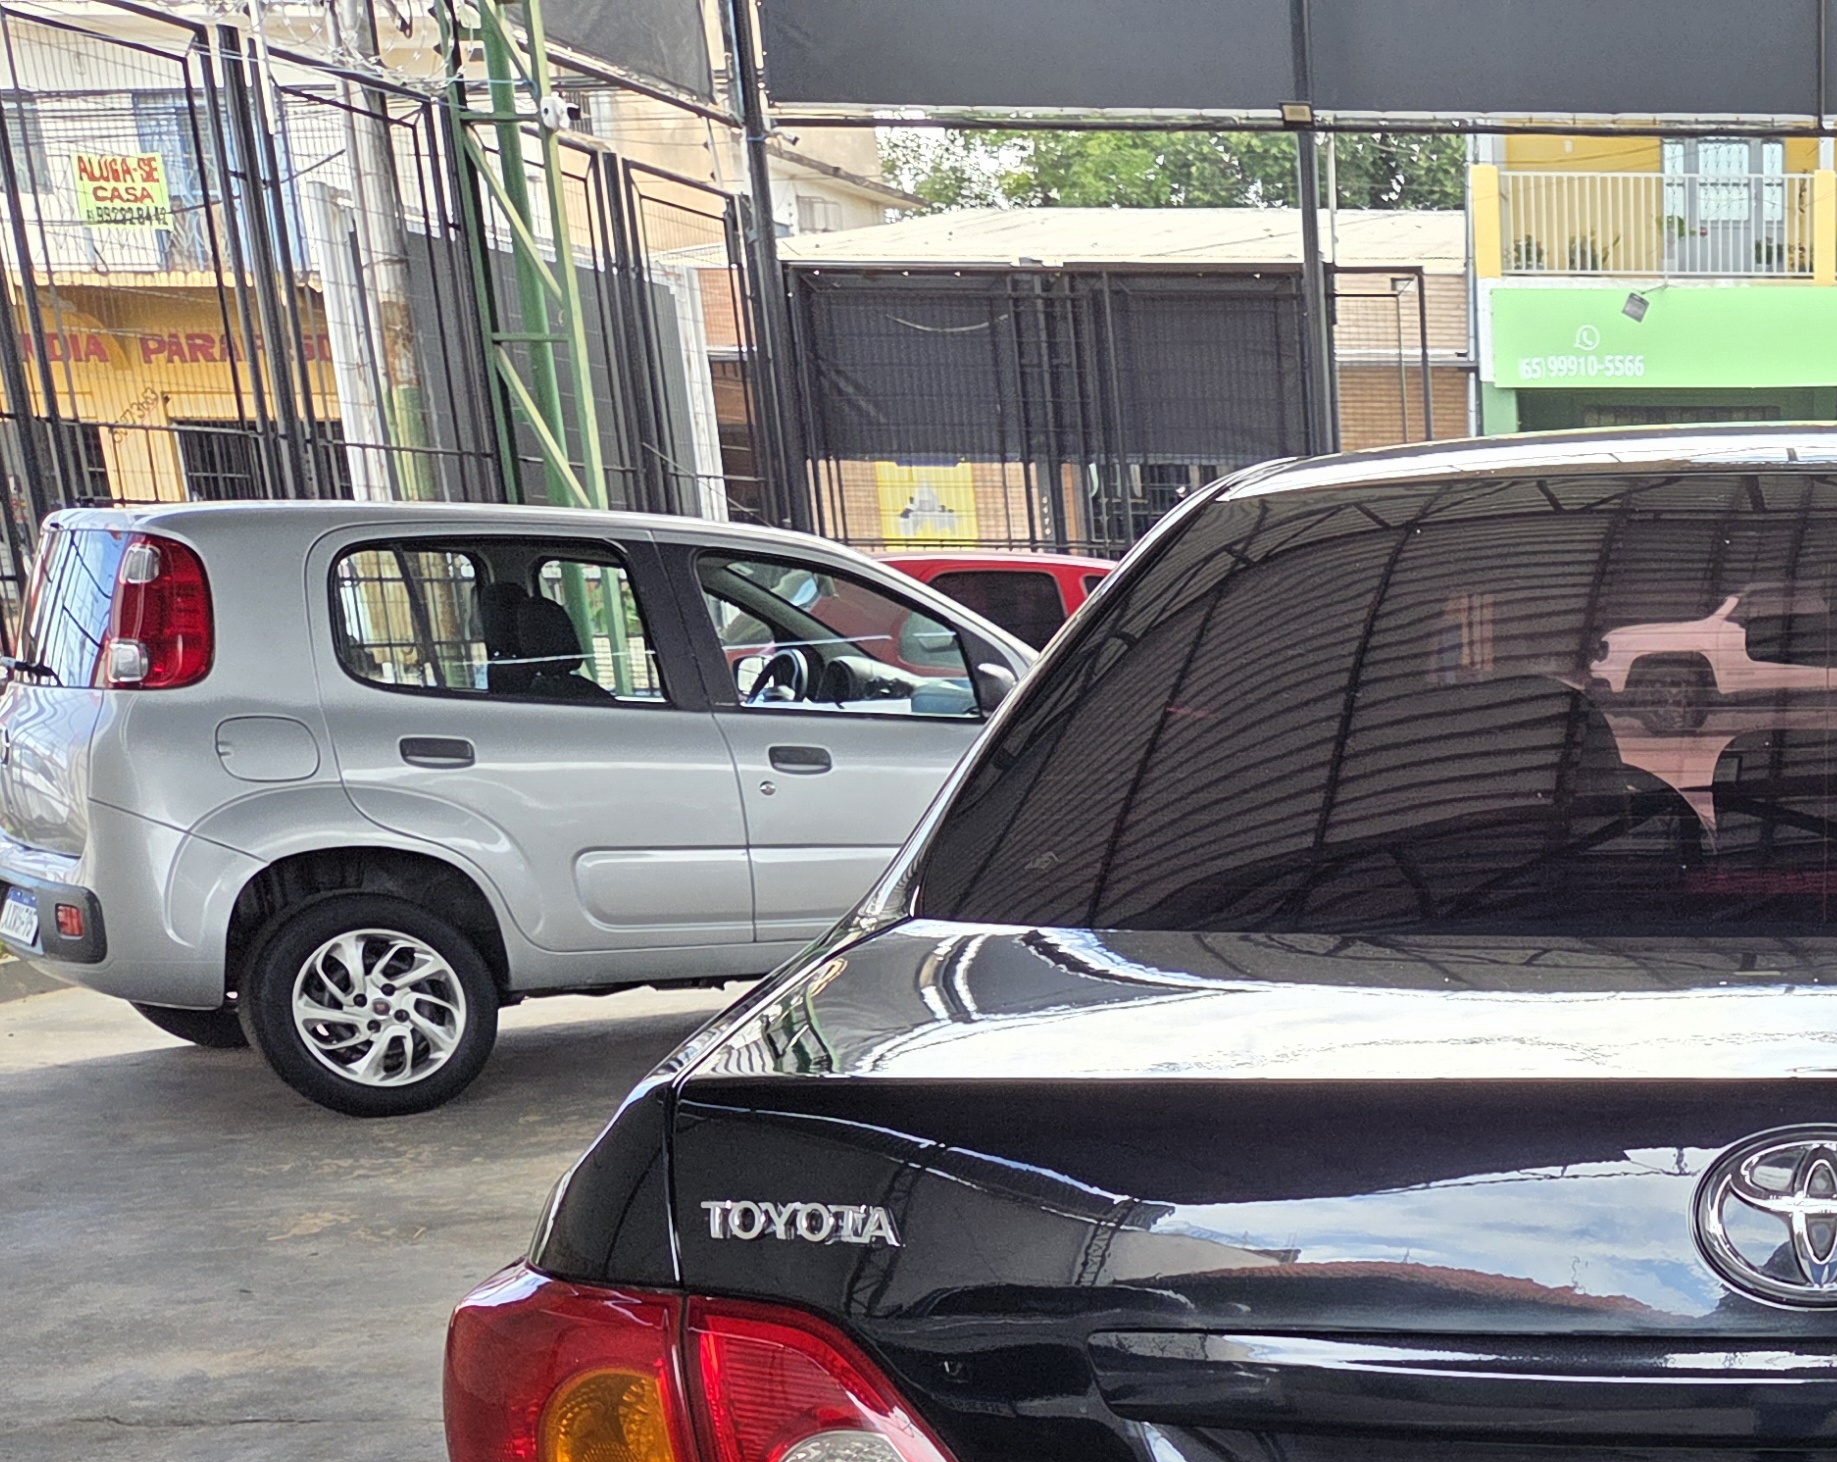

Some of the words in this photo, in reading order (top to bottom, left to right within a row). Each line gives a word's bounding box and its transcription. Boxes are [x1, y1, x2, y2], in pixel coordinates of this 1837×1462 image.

[77, 156, 160, 183] ALUGA-SE
[92, 186, 155, 203] CASA
[1519, 357, 1547, 379] (65)
[1547, 354, 1646, 377] 99910-5566
[700, 1200, 901, 1247] TOYOTA
